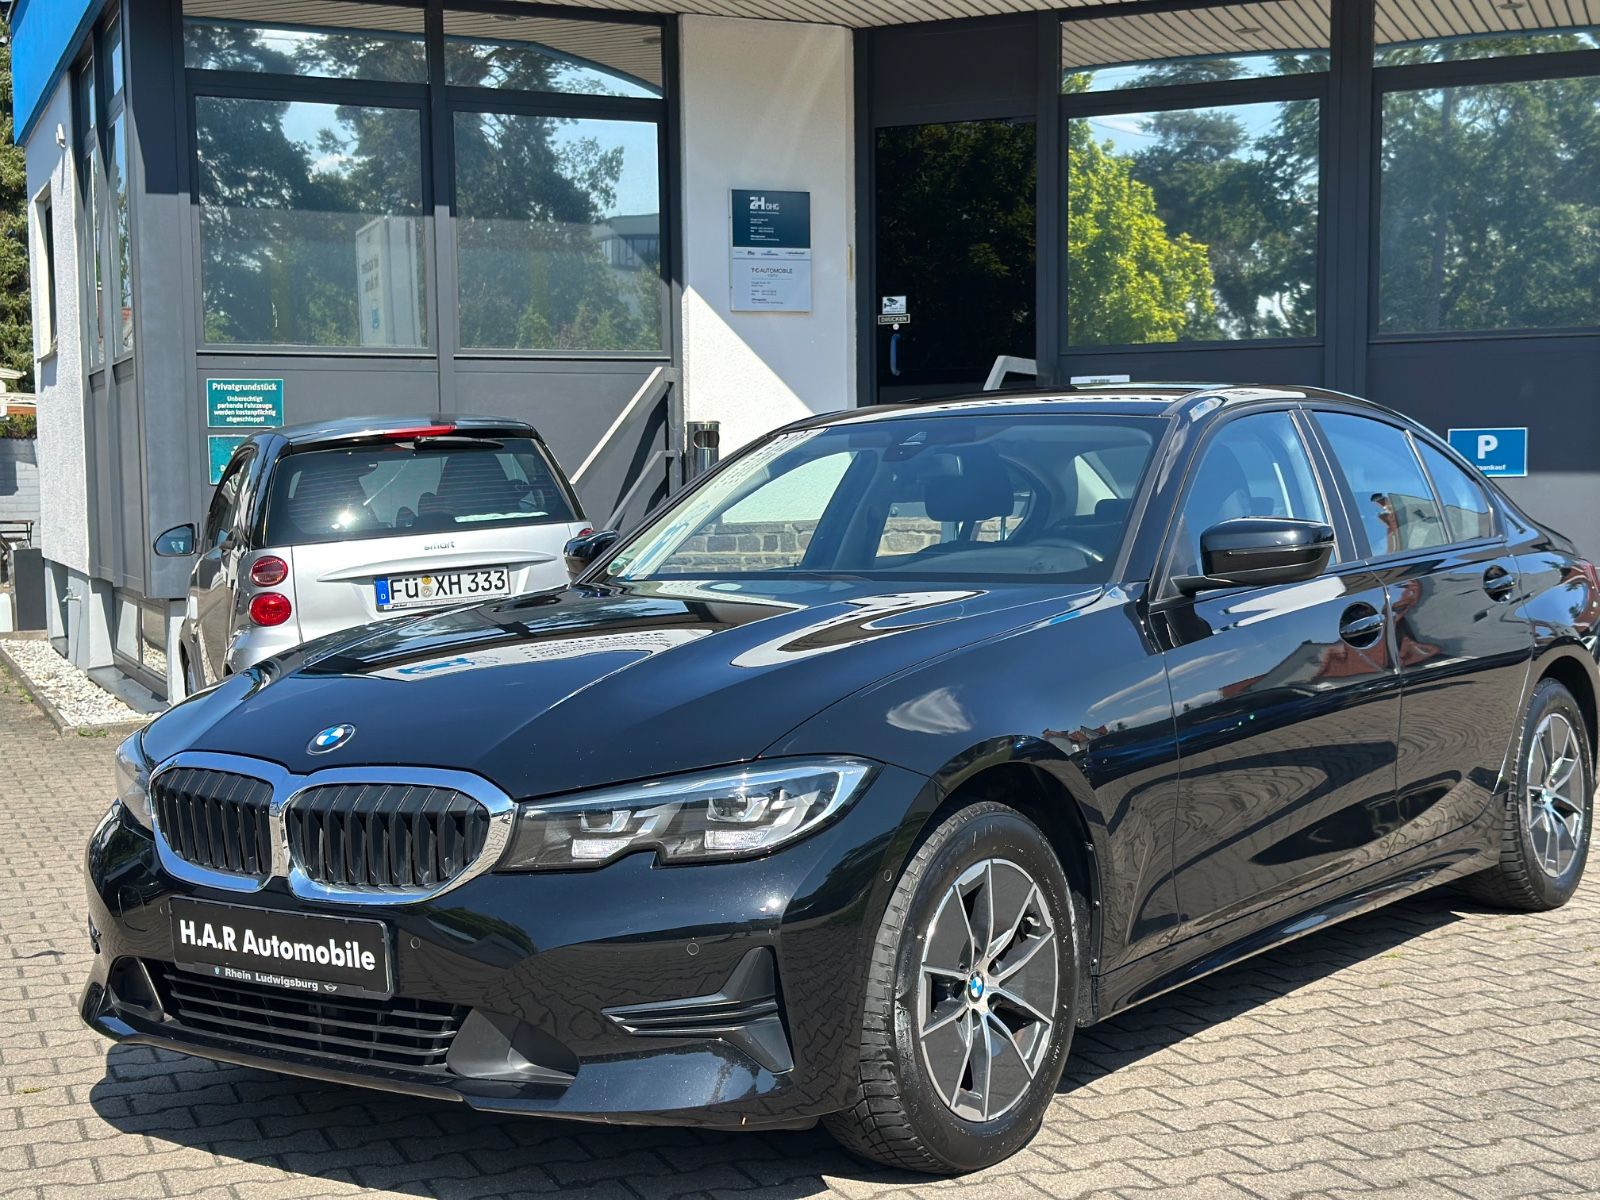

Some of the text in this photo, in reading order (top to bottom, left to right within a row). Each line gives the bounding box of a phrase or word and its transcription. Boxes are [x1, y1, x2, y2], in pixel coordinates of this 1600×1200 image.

[212, 383, 277, 392] Privatgrundstück
[1477, 434, 1498, 459] P
[424, 541, 455, 550] smart
[390, 570, 506, 600] FÜ XH 333
[179, 919, 376, 971] H.A.R Automobile
[224, 968, 319, 991] Rhein Ludwigsburg
